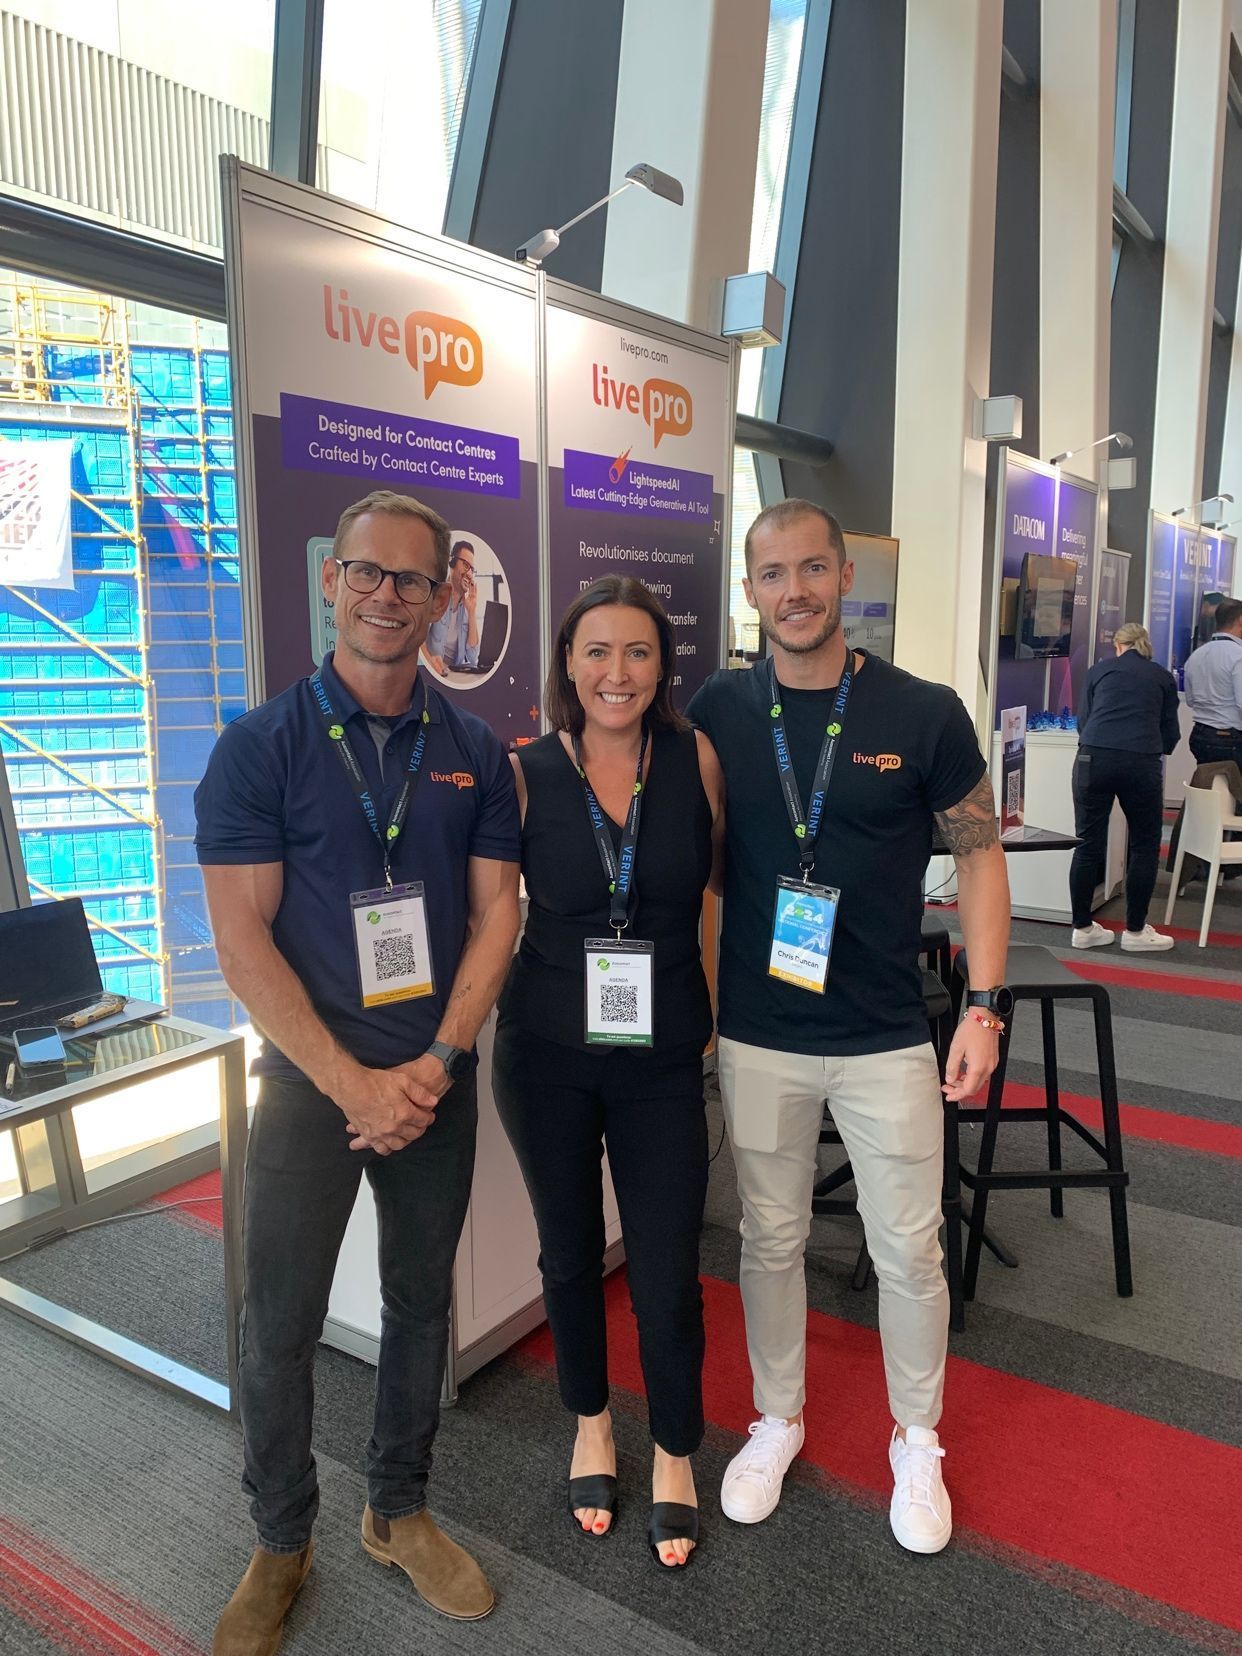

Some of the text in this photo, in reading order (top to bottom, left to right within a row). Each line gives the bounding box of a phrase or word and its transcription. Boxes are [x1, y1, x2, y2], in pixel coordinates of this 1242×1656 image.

[620, 337, 669, 364] livepro.com
[318, 414, 496, 461] Designed for Contact Centres
[308, 442, 504, 487] Crafted by Contact Centre Experts
[629, 471, 680, 491] LightspeedAI
[571, 484, 709, 515] Latest Cutting-Edge Generative AI Tool
[1013, 514, 1046, 541] DATACOM
[1062, 528, 1087, 548] Delivering
[579, 541, 694, 565] Revolutionises document
[638, 579, 672, 598] llowing
[667, 611, 697, 626] transfer
[310, 674, 334, 716] VERINT
[835, 671, 851, 714] VERINT
[408, 731, 427, 773] VERINT
[773, 727, 791, 773] VERINT
[584, 788, 604, 829] VERINT
[808, 790, 825, 837] VERINT
[618, 845, 633, 893] VERINT
[777, 950, 794, 961] Chris
